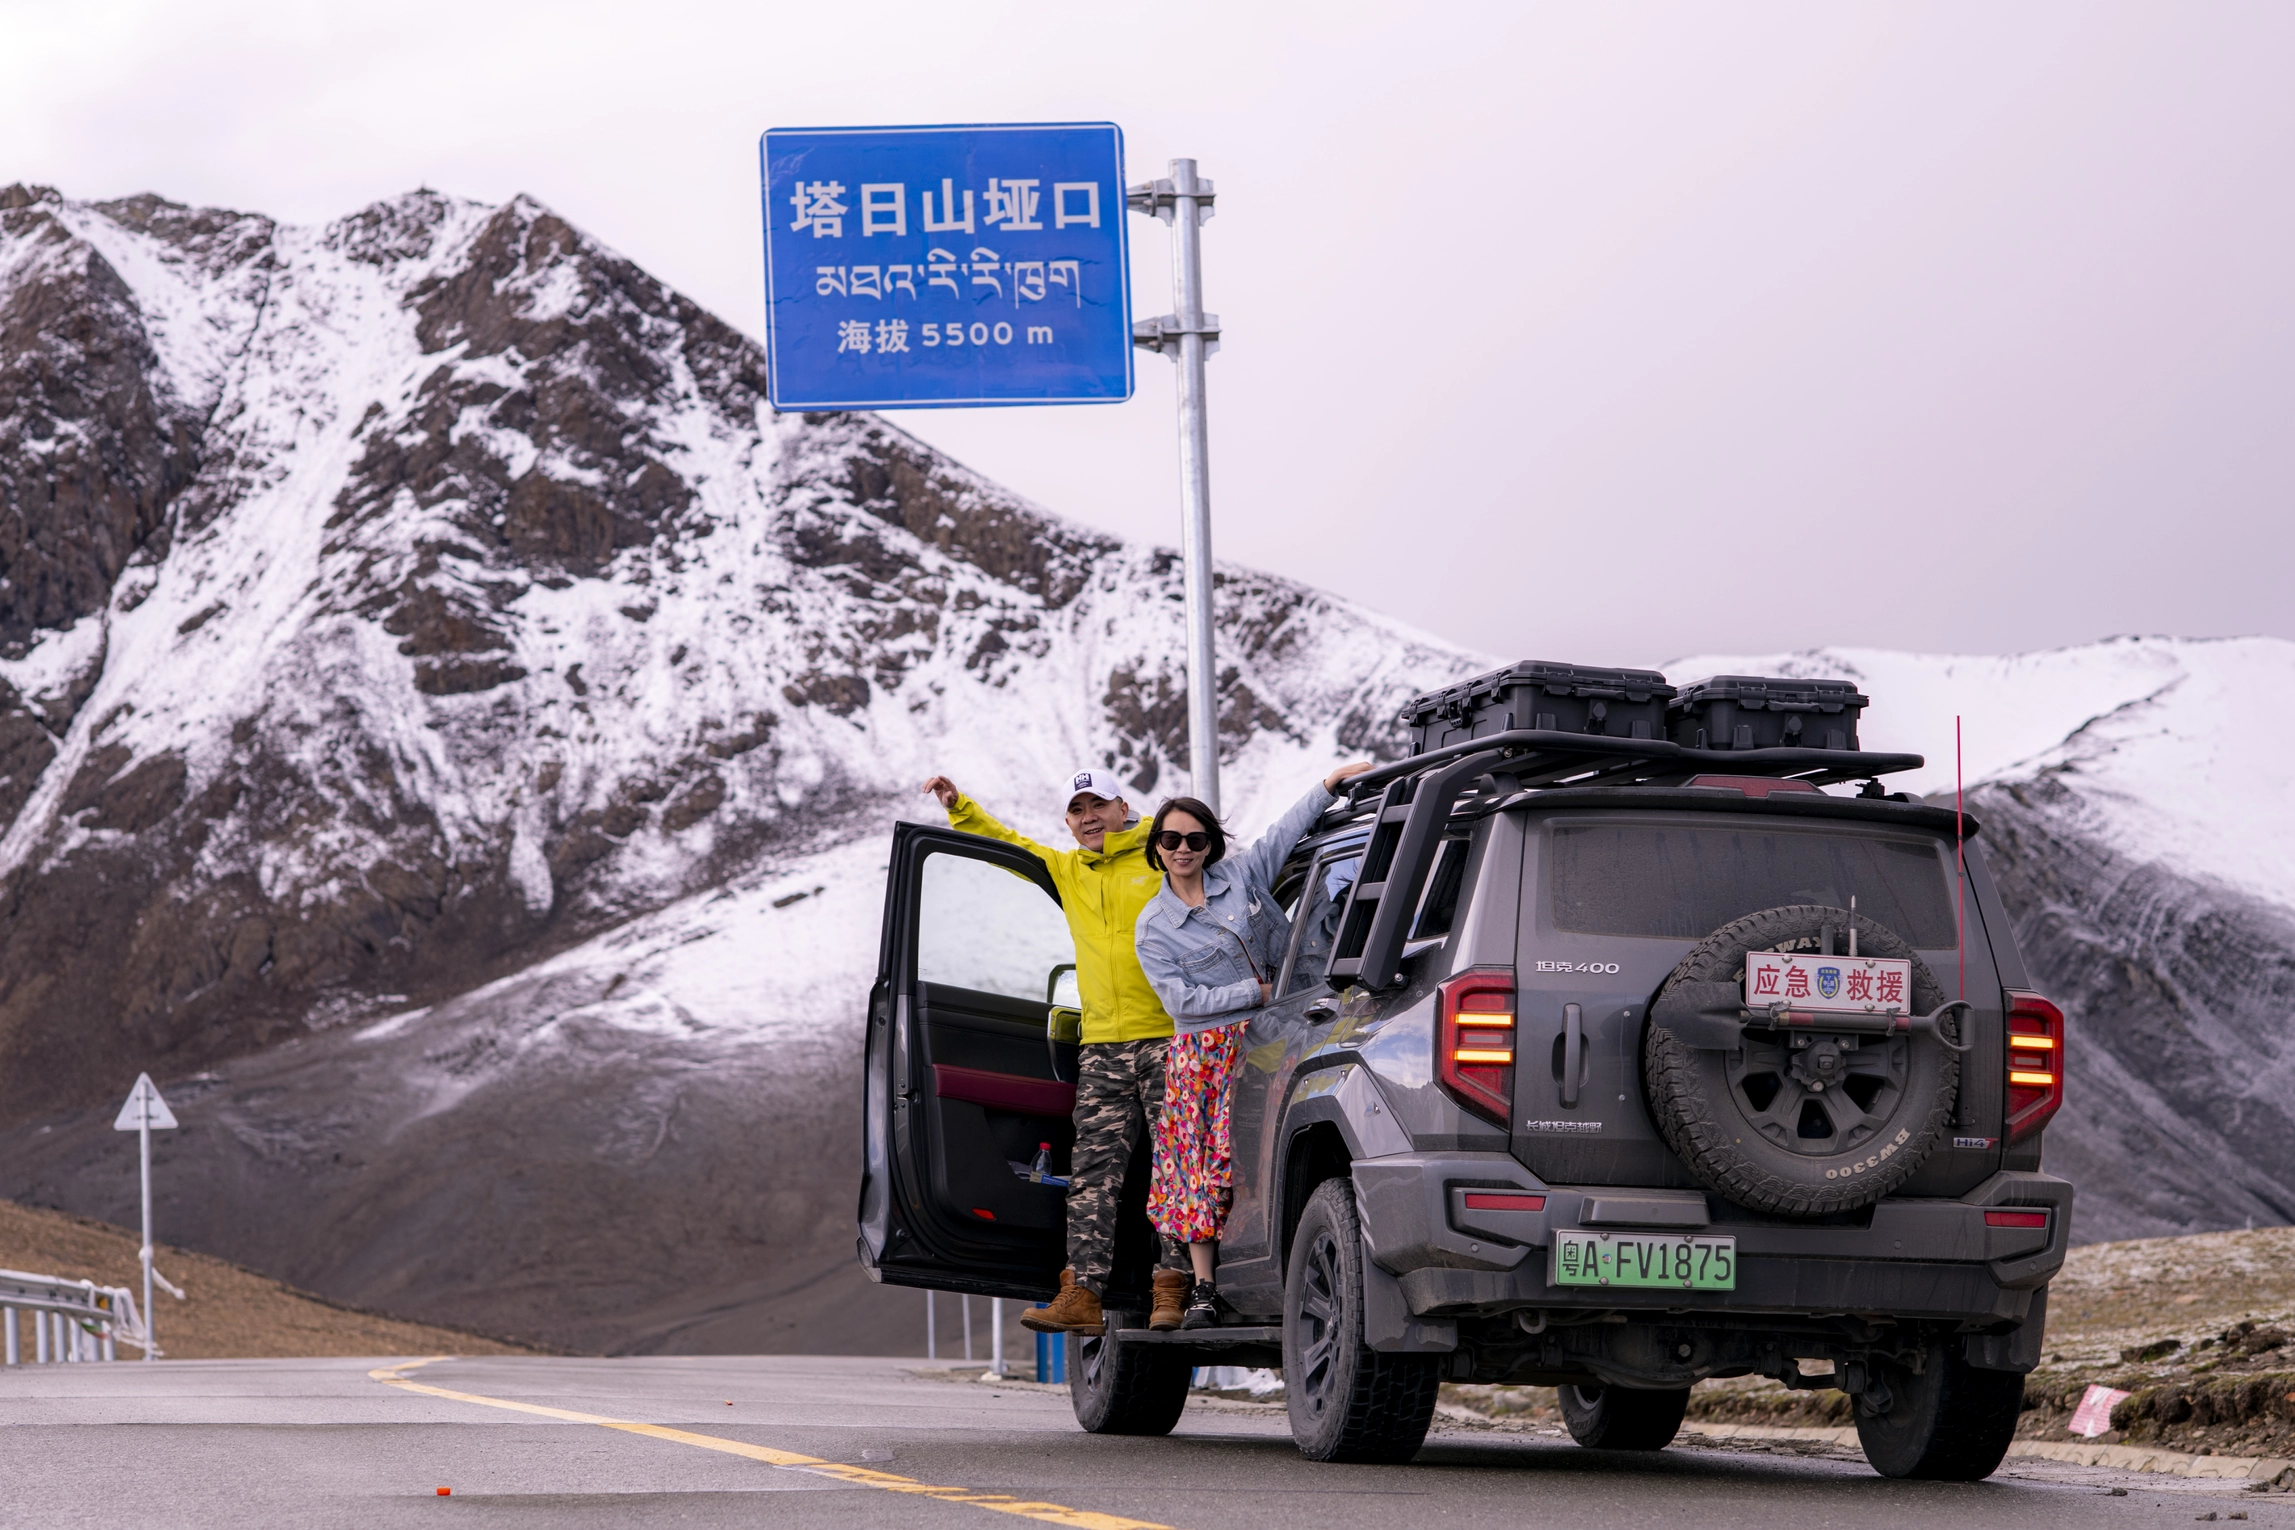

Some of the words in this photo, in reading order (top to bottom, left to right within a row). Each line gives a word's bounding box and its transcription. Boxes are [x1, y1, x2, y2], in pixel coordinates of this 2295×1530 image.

[790, 178, 1100, 238] 塔日山垭口
[837, 319, 910, 354] 海拔
[922, 322, 1013, 347] 5500
[1028, 326, 1053, 344] m
[1535, 961, 1620, 974] 坦克400
[1754, 964, 1811, 998] 应急
[1847, 969, 1903, 1003] 救援
[1526, 1120, 1602, 1134] 长城坦克越野
[1825, 1128, 1912, 1180] BW3300
